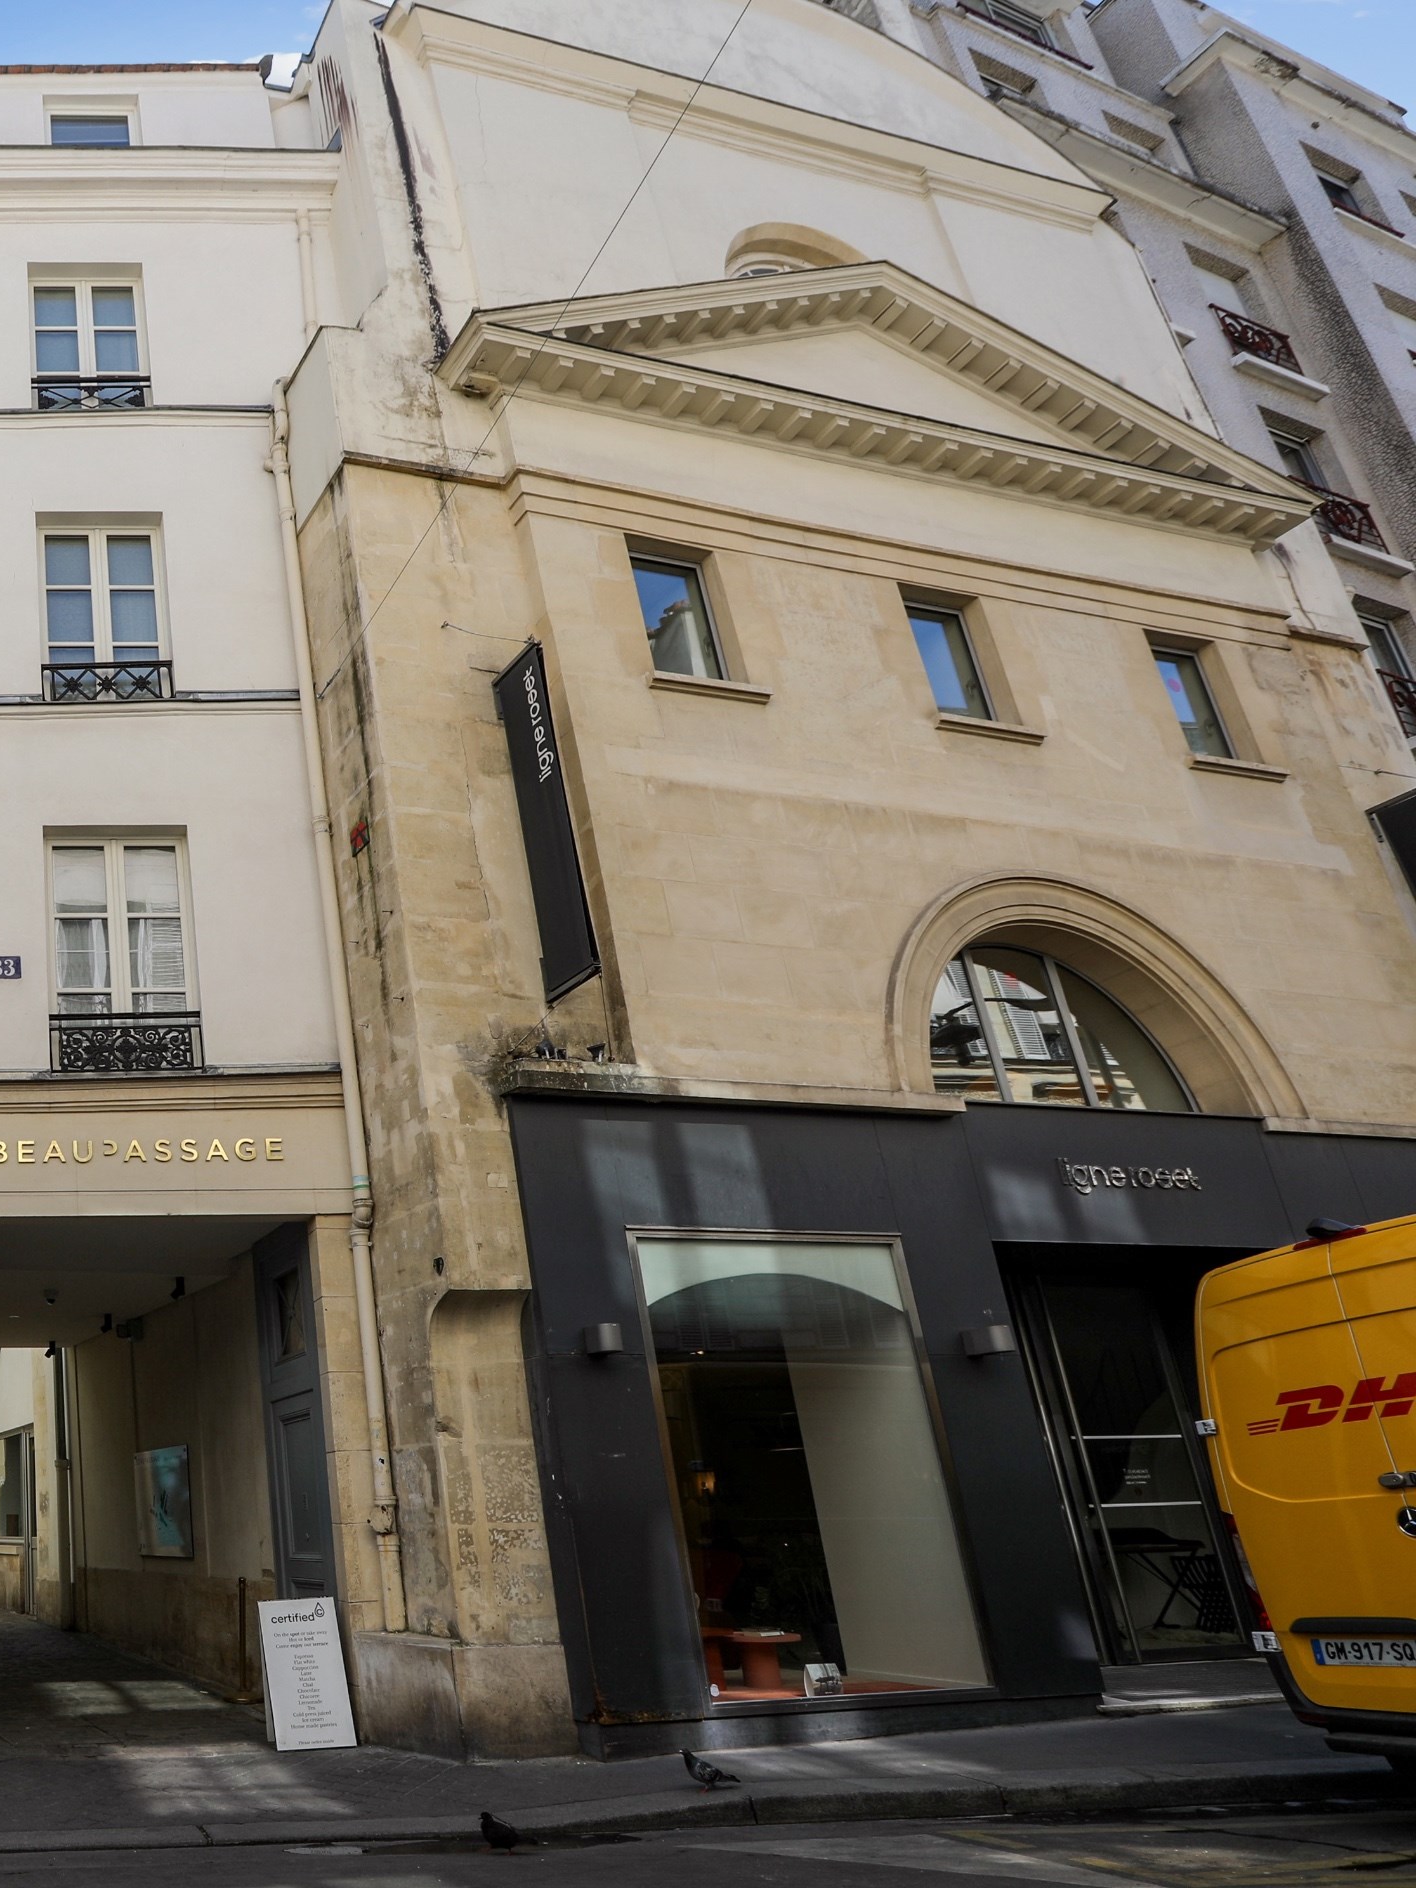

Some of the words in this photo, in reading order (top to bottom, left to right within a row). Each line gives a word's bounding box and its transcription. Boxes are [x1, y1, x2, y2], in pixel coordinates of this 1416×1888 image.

[534, 725, 554, 783] ligne
[1057, 1157, 1126, 1194] ligne
[1128, 1166, 1202, 1190] roset
[271, 1612, 315, 1624] certified
[1325, 1642, 1416, 1661] GM-917-SQ
